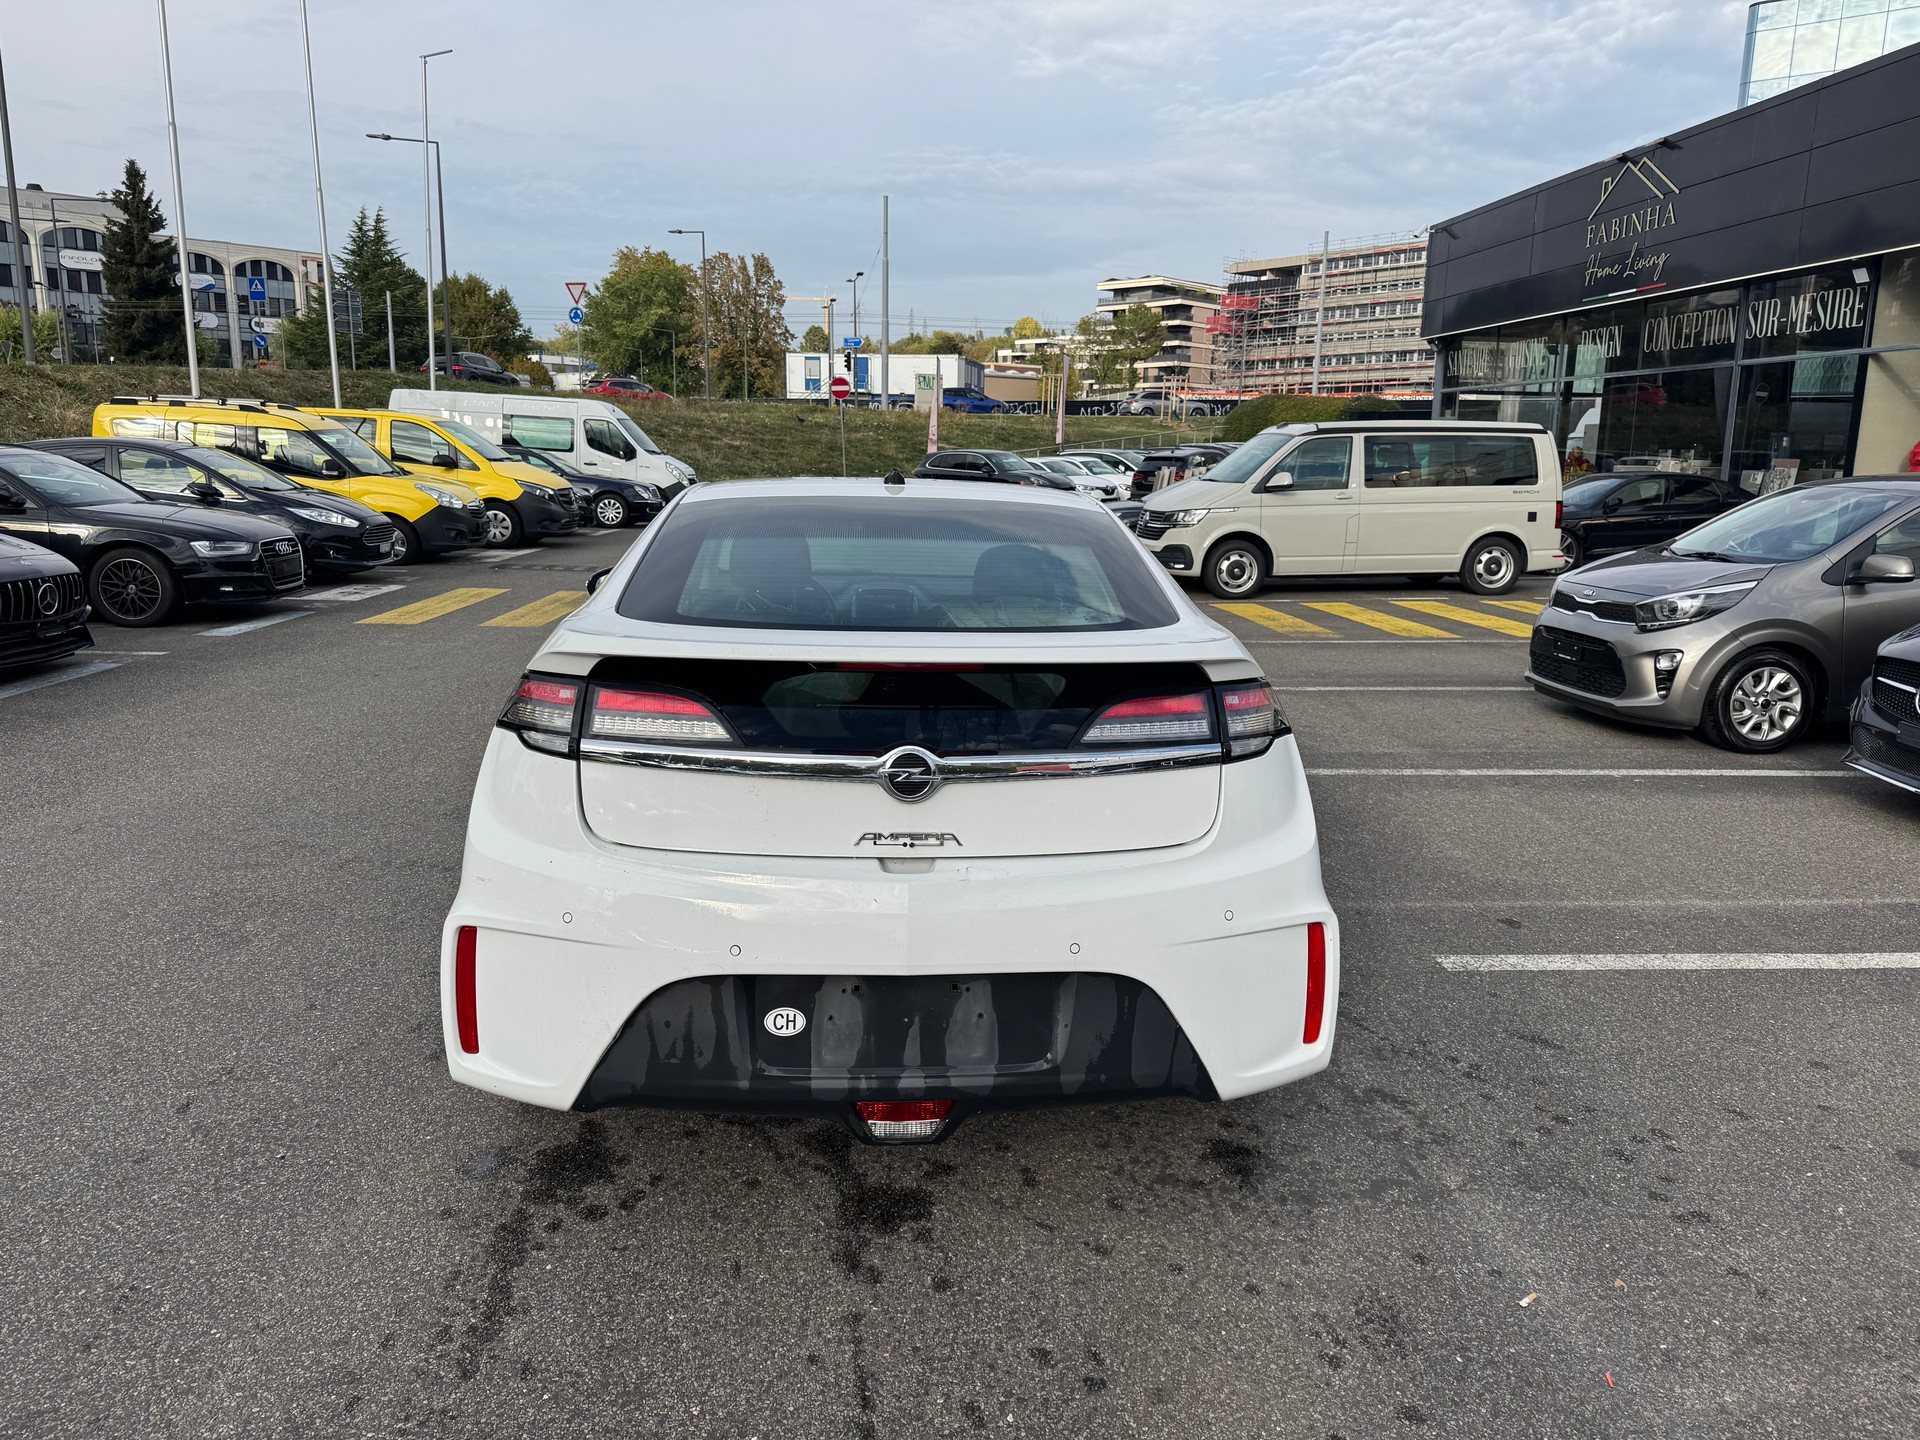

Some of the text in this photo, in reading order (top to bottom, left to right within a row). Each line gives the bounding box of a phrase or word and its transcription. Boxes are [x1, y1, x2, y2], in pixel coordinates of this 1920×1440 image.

[1585, 202, 1676, 248] FABINHA
[1585, 242, 1670, 287] Home Living
[1581, 325, 1624, 360] DESIGN
[1643, 306, 1739, 352] CONCEPTION
[1746, 286, 1868, 340] SUR-MESURE
[854, 832, 963, 846] AMPERA
[773, 1013, 797, 1031] CH
